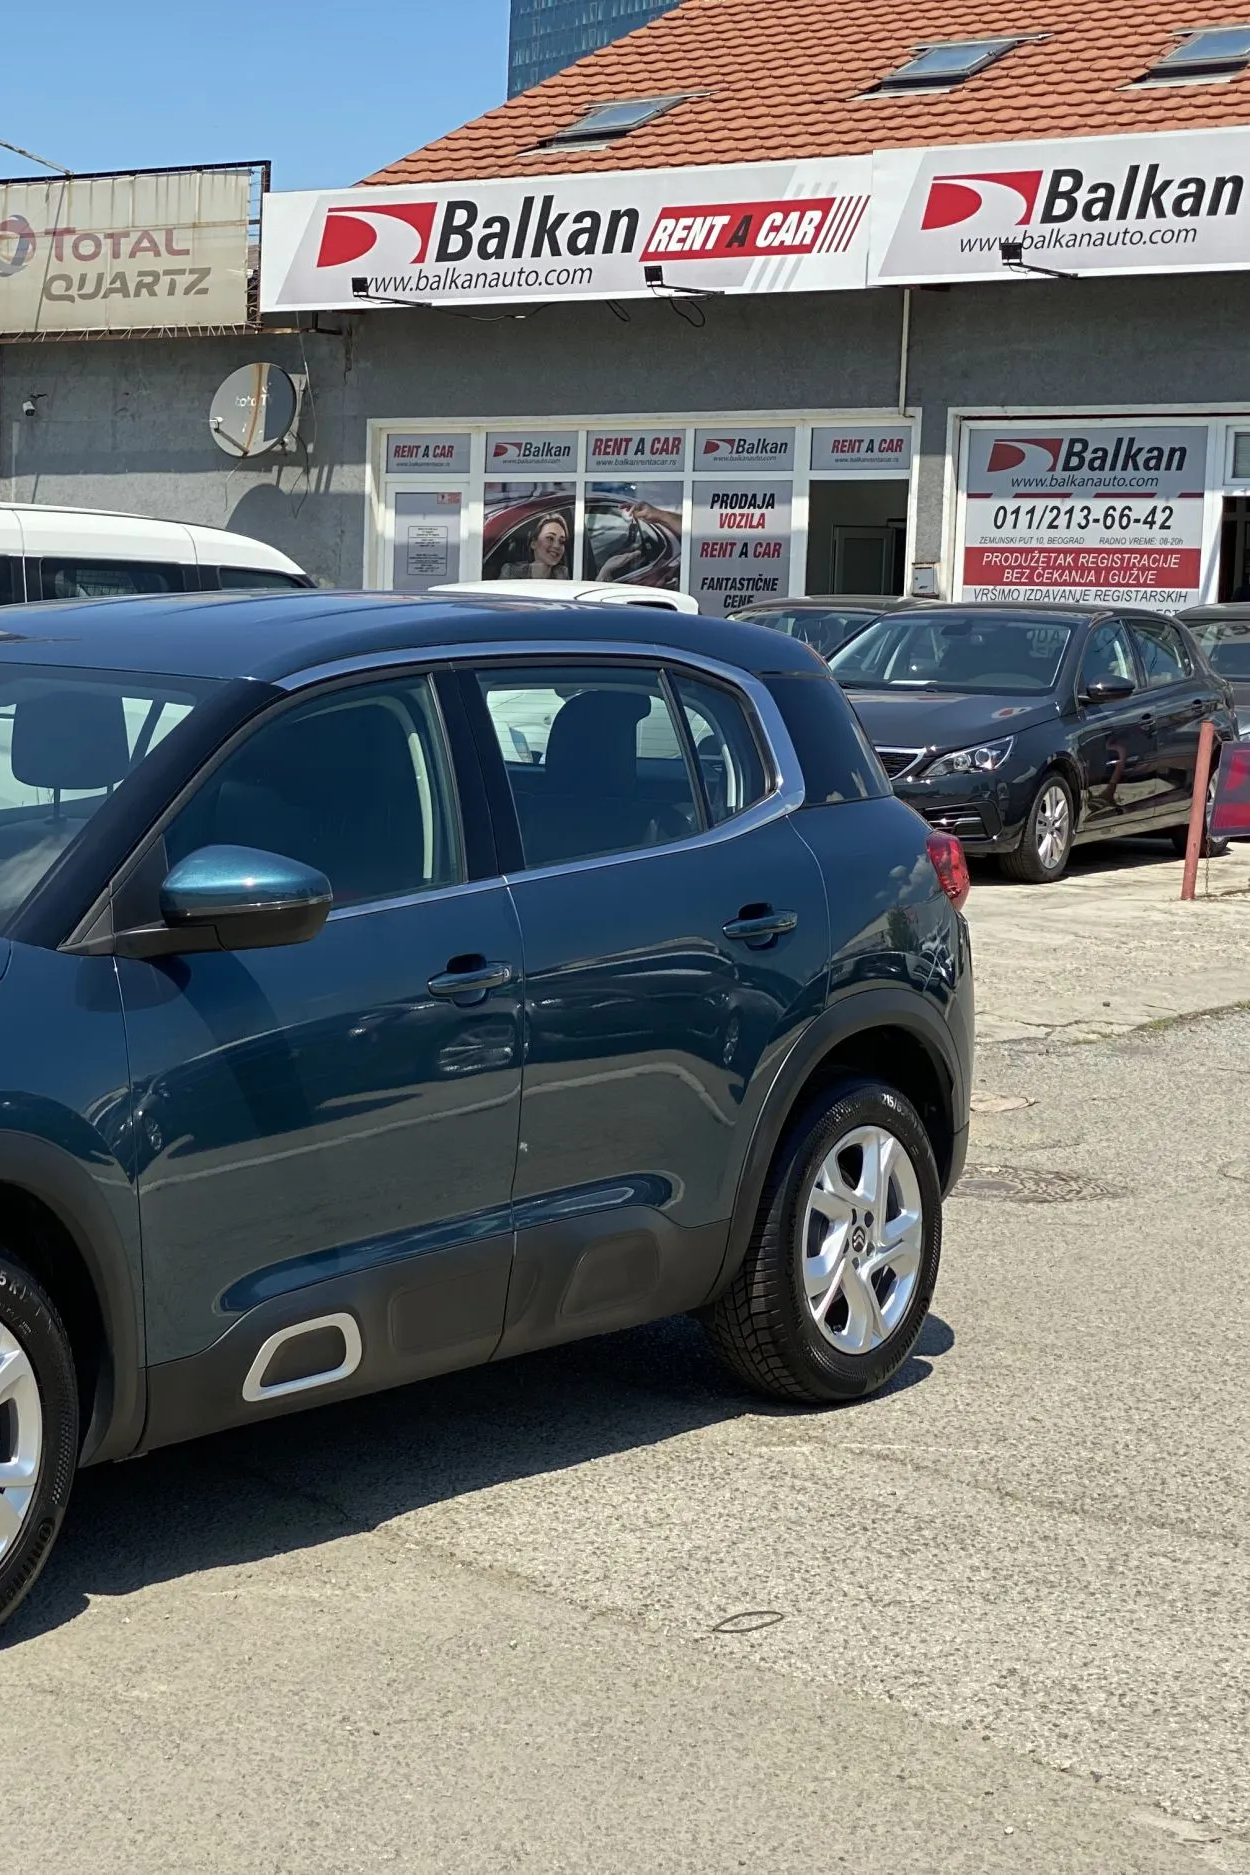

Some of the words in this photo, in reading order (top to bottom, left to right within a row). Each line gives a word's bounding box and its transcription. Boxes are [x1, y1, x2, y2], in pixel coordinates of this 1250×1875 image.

[1040, 163, 1244, 224] Balkan
[435, 194, 640, 264] Balkan
[650, 217, 729, 252] RENT
[725, 215, 753, 248] A
[756, 211, 821, 247] CAR
[960, 226, 1197, 252] wwbalkanauto.com
[43, 267, 211, 303] QUARTZ
[393, 444, 421, 458] RENT
[422, 445, 430, 457] A
[432, 445, 454, 458] CAR
[521, 442, 571, 458] Balkan
[592, 437, 632, 456] RENT
[634, 437, 645, 455] A
[650, 437, 682, 455] CAR
[735, 438, 788, 454] Balkan
[831, 439, 863, 453] RENT
[865, 439, 874, 453] A
[878, 439, 904, 453] CAR
[1062, 437, 1187, 472] Balkan
[596, 458, 677, 467] www.balkanrentacar.rs
[1011, 474, 1158, 488] www.balkanauto.com
[710, 493, 775, 509] PRODAJA
[719, 513, 765, 529] VOZILA
[993, 505, 1174, 530] 011/213-66-42
[700, 542, 737, 558] RENT
[738, 542, 748, 558] A
[753, 542, 782, 558] CAR
[979, 537, 1017, 545] ZEMUNSKI
[1019, 537, 1034, 545] PUT
[1047, 537, 1085, 545] BEOGRAD
[1099, 537, 1126, 546] RADNO
[983, 550, 1076, 567] PRODUŽETAK
[1078, 554, 1180, 568] REGISTRACIJE
[701, 573, 779, 592] FANTASTIČNE
[1003, 570, 1029, 582] BEZ
[1034, 567, 1095, 583] ČEKANJA
[1109, 567, 1157, 584] GUŽVE
[974, 586, 1020, 601] VRŠIMO
[1023, 588, 1091, 603] IZDAVANJE
[1094, 590, 1187, 603] REGISTARSKIH
